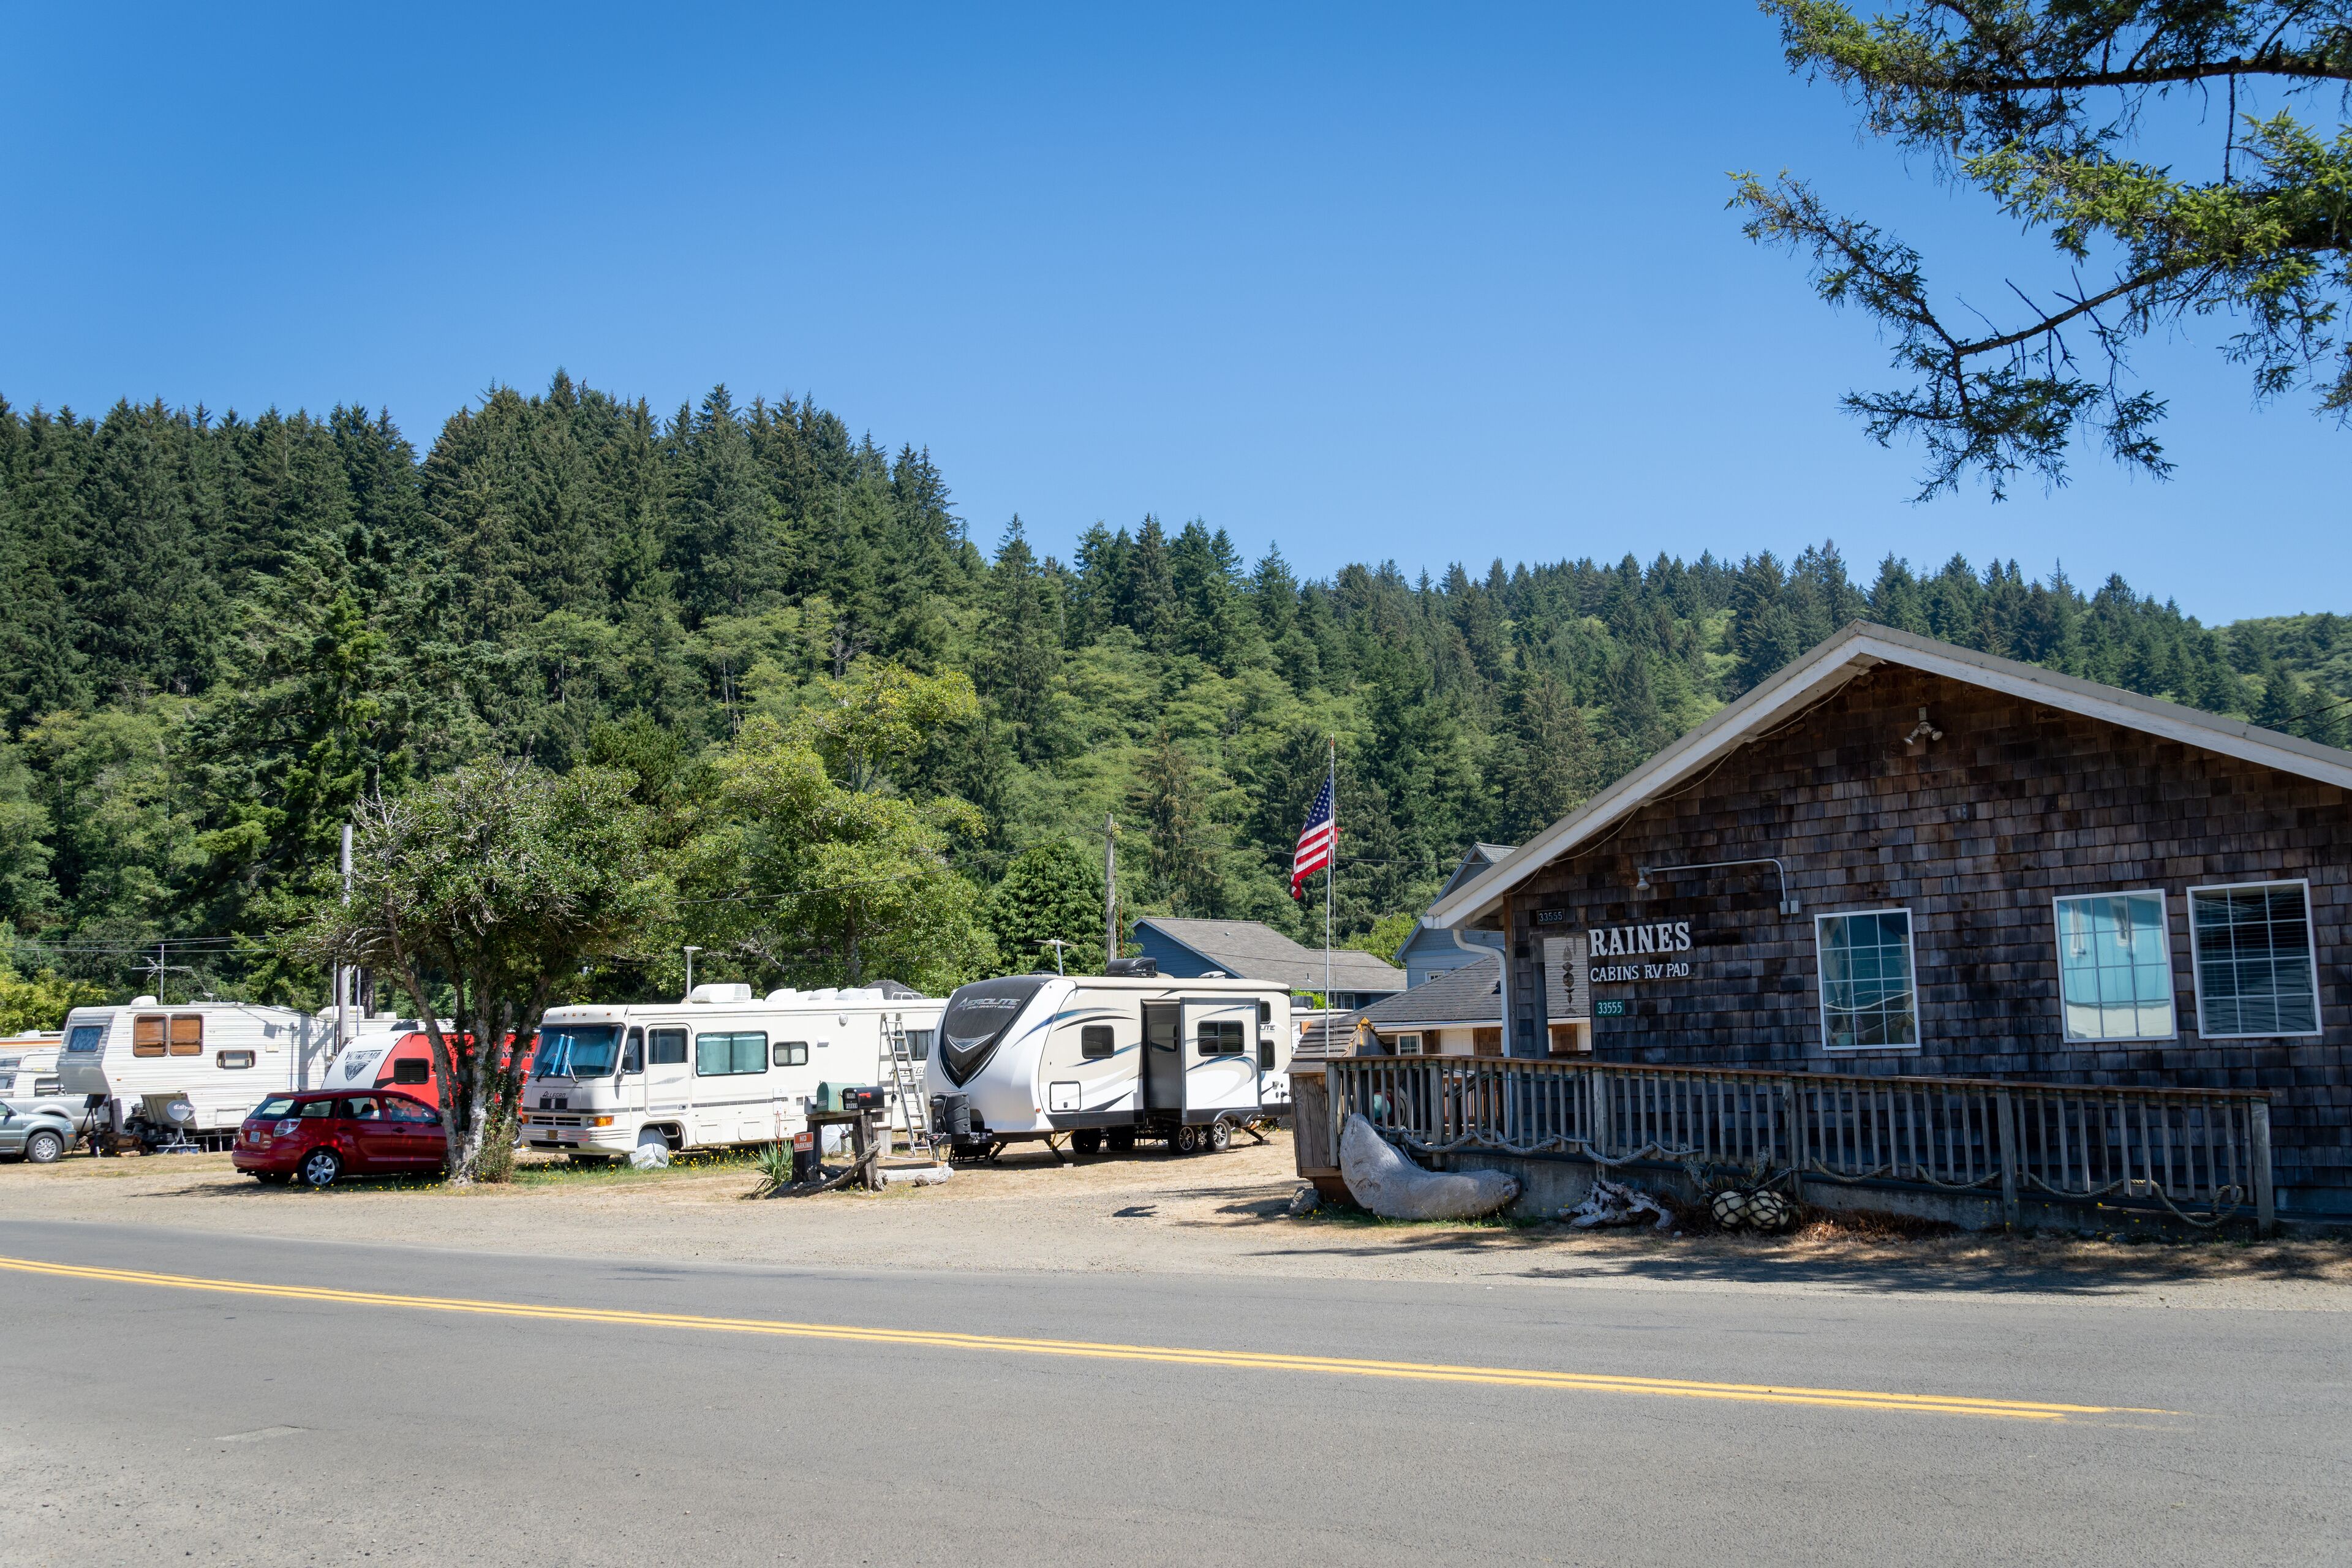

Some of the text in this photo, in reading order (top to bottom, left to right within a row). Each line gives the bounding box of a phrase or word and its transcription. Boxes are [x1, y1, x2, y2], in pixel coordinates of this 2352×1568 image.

[1539, 911, 1562, 922] 33555
[1588, 922, 1691, 957] RAINES
[1590, 963, 1689, 982] CABINS RV PAD
[952, 997, 1021, 1011] AEROLITE
[1597, 1001, 1623, 1014] 33555
[345, 1050, 383, 1060] WNNEAGO
